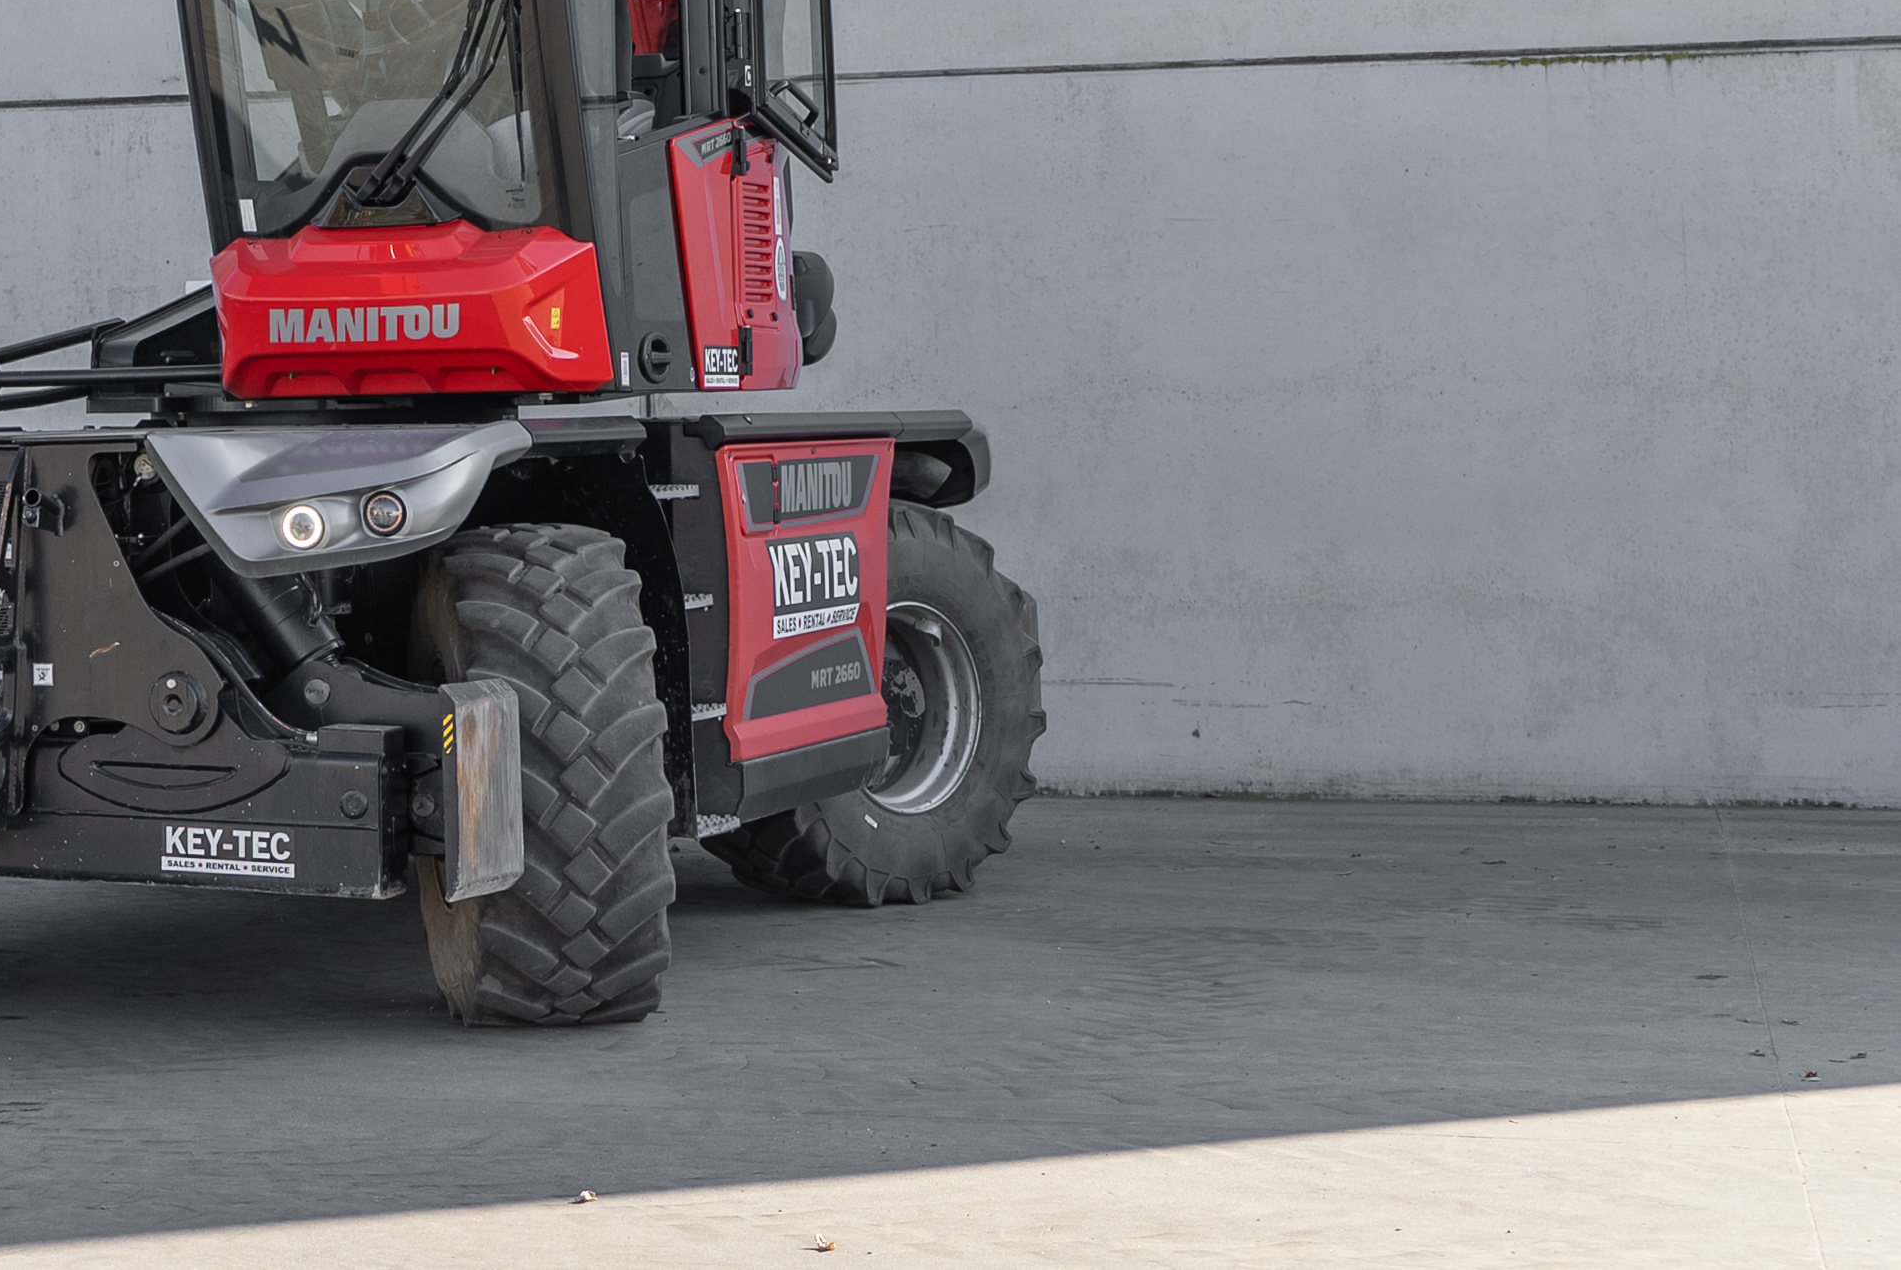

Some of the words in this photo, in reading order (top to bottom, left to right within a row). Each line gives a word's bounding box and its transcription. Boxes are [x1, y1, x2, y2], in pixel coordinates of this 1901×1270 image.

[268, 303, 460, 344] MANITOU
[704, 348, 739, 373] KEY-TEC
[780, 461, 852, 513] MANITOU
[768, 536, 858, 607] KEY-TEC
[776, 617, 797, 634] SALES
[803, 611, 826, 630] RENTAL
[830, 606, 857, 625] SERVICE
[811, 666, 834, 690] MRT
[834, 661, 861, 684] 2660
[165, 825, 291, 861] KEY-TEC
[167, 859, 196, 869] SALES
[205, 861, 241, 872] RENTAL
[251, 864, 290, 874] SERVICE
